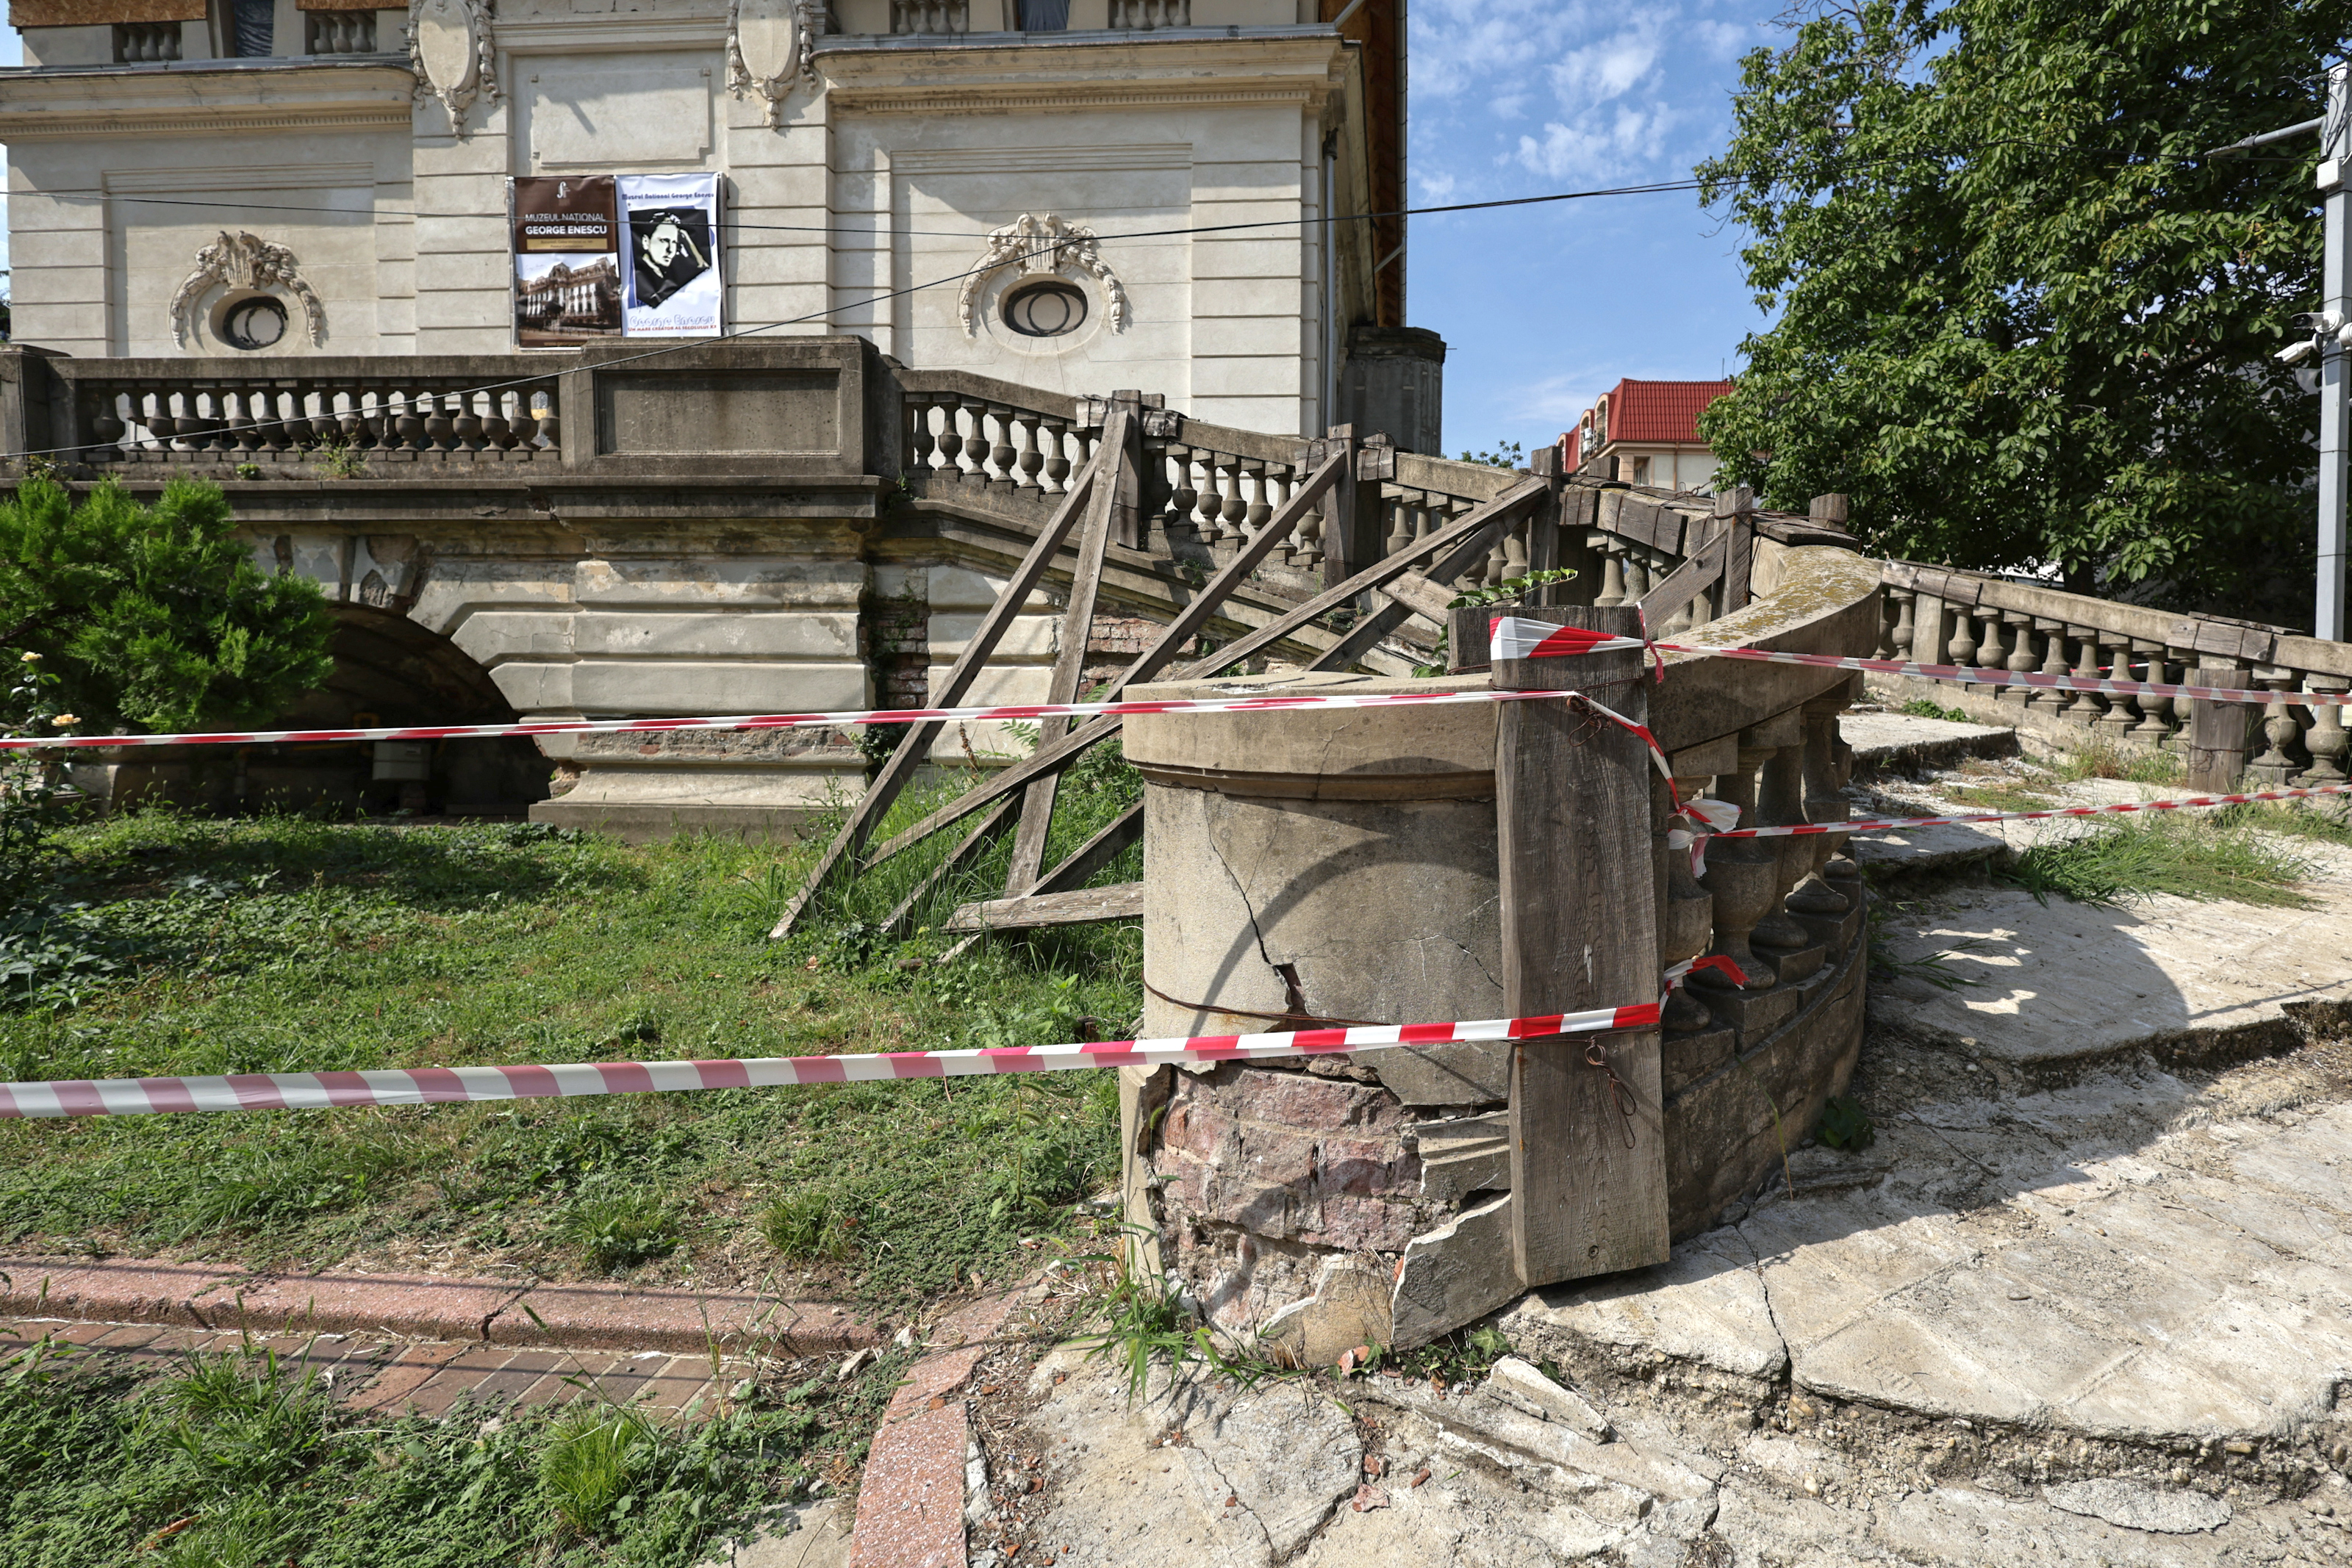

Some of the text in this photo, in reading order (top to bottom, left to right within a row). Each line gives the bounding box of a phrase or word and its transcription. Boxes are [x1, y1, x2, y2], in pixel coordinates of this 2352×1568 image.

[526, 213, 560, 222] MUZEUL
[525, 225, 608, 234] GEORGE ENESCU
